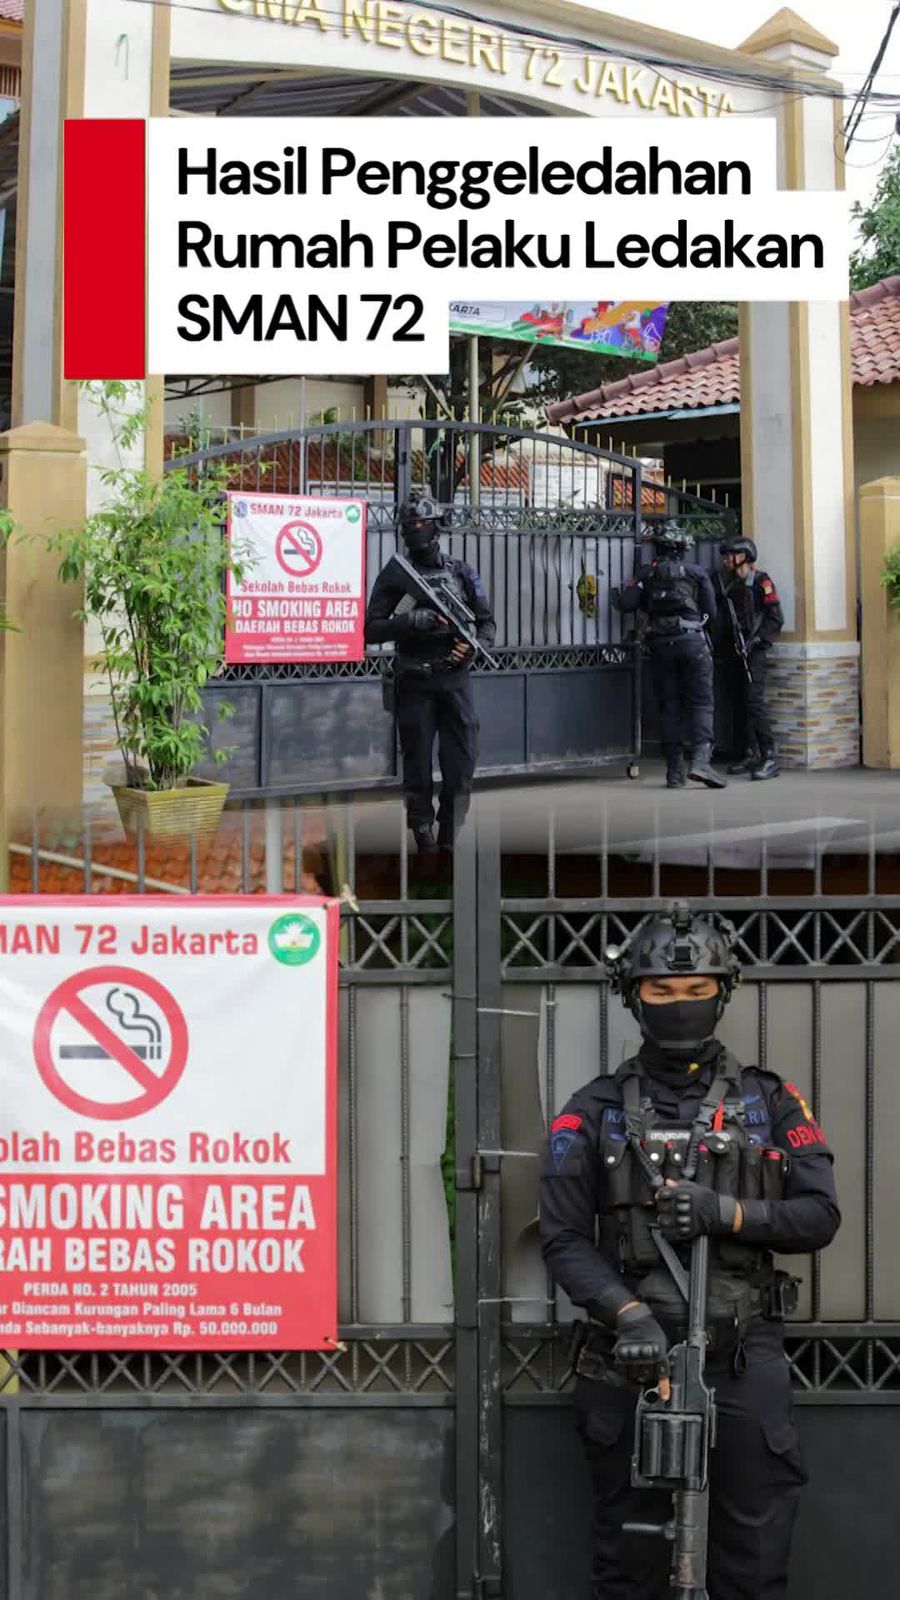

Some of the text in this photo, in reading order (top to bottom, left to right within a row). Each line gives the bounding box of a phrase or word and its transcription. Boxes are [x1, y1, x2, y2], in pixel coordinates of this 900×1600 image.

[342, 0, 508, 74] NEGERI
[522, 39, 564, 88] 72
[575, 54, 736, 117] JAKARTA
[250, 503, 343, 519] SMAN 72 Jakarta
[241, 581, 352, 593] Sekolah Bebas Rokok
[258, 600, 321, 617] SMOKING
[325, 601, 358, 617] AREA
[235, 619, 356, 633] DAERAH BEBAS ROKOK
[75, 924, 118, 955] 72
[131, 925, 258, 955] Jakarta
[74, 1131, 176, 1162] Bebas
[189, 1132, 290, 1163] Rokok
[0, 1183, 316, 1230] MOKING AREA
[65, 1237, 176, 1272] BEBAS
[188, 1238, 305, 1273] ROKOK
[24, 1282, 198, 1297] PERDA NO. 2 TAHUN 2005
[12, 1301, 71, 1316] Diancam
[75, 1302, 139, 1319] Kurungan
[143, 1301, 186, 1319] Paling
[190, 1302, 227, 1316] Lama
[230, 1302, 239, 1316] 6
[243, 1302, 282, 1316] Bulan
[173, 1321, 195, 1338] Rp.
[199, 1321, 278, 1335] 50.000.000
